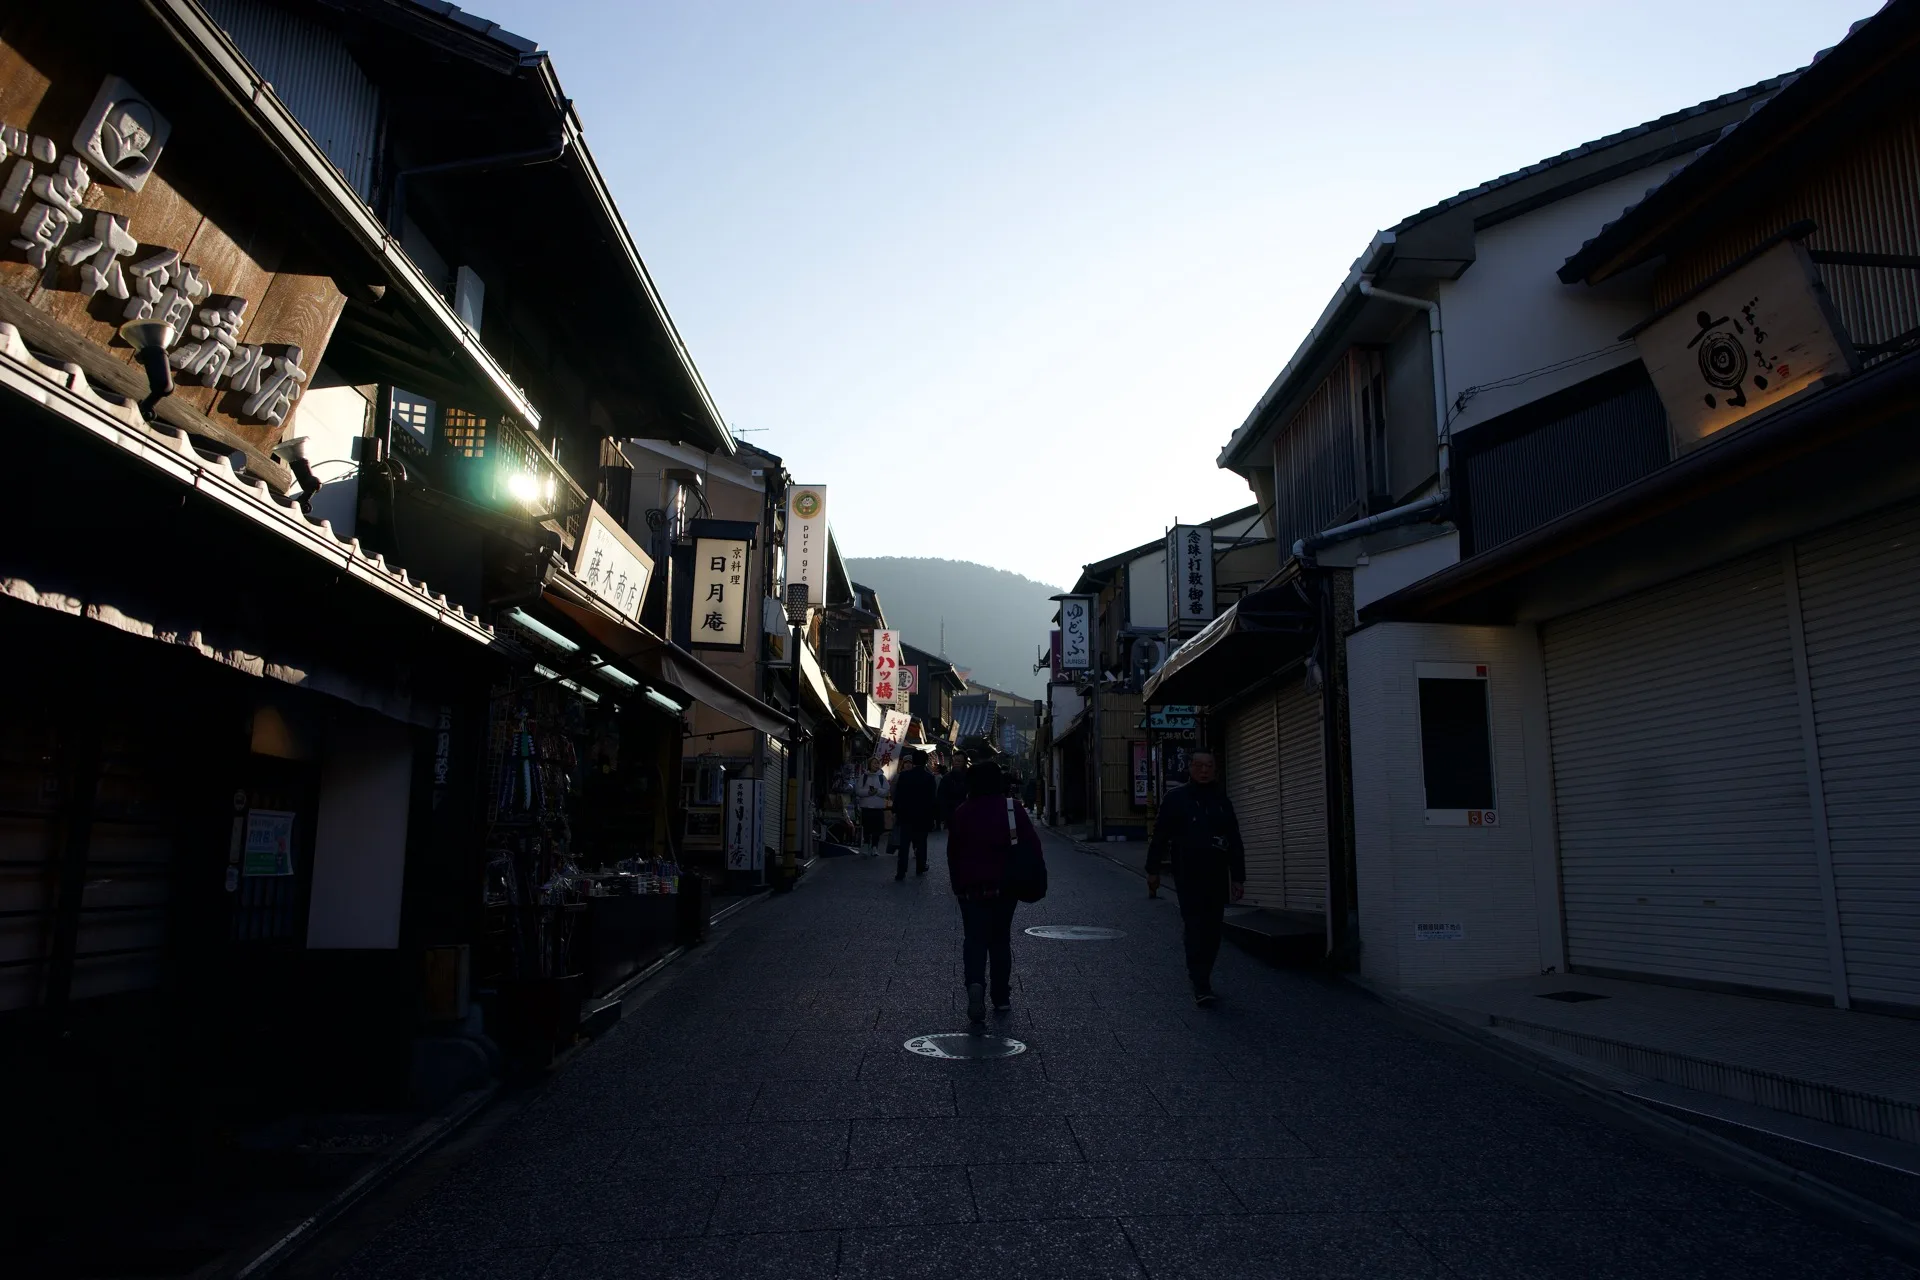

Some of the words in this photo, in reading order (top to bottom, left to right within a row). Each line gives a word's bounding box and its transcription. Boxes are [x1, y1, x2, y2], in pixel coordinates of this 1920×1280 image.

[587, 547, 638, 613] 藤木商店
[701, 556, 727, 632] 日月庵
[730, 547, 742, 585] 京料理
[1067, 603, 1085, 657] ゆどうふ
